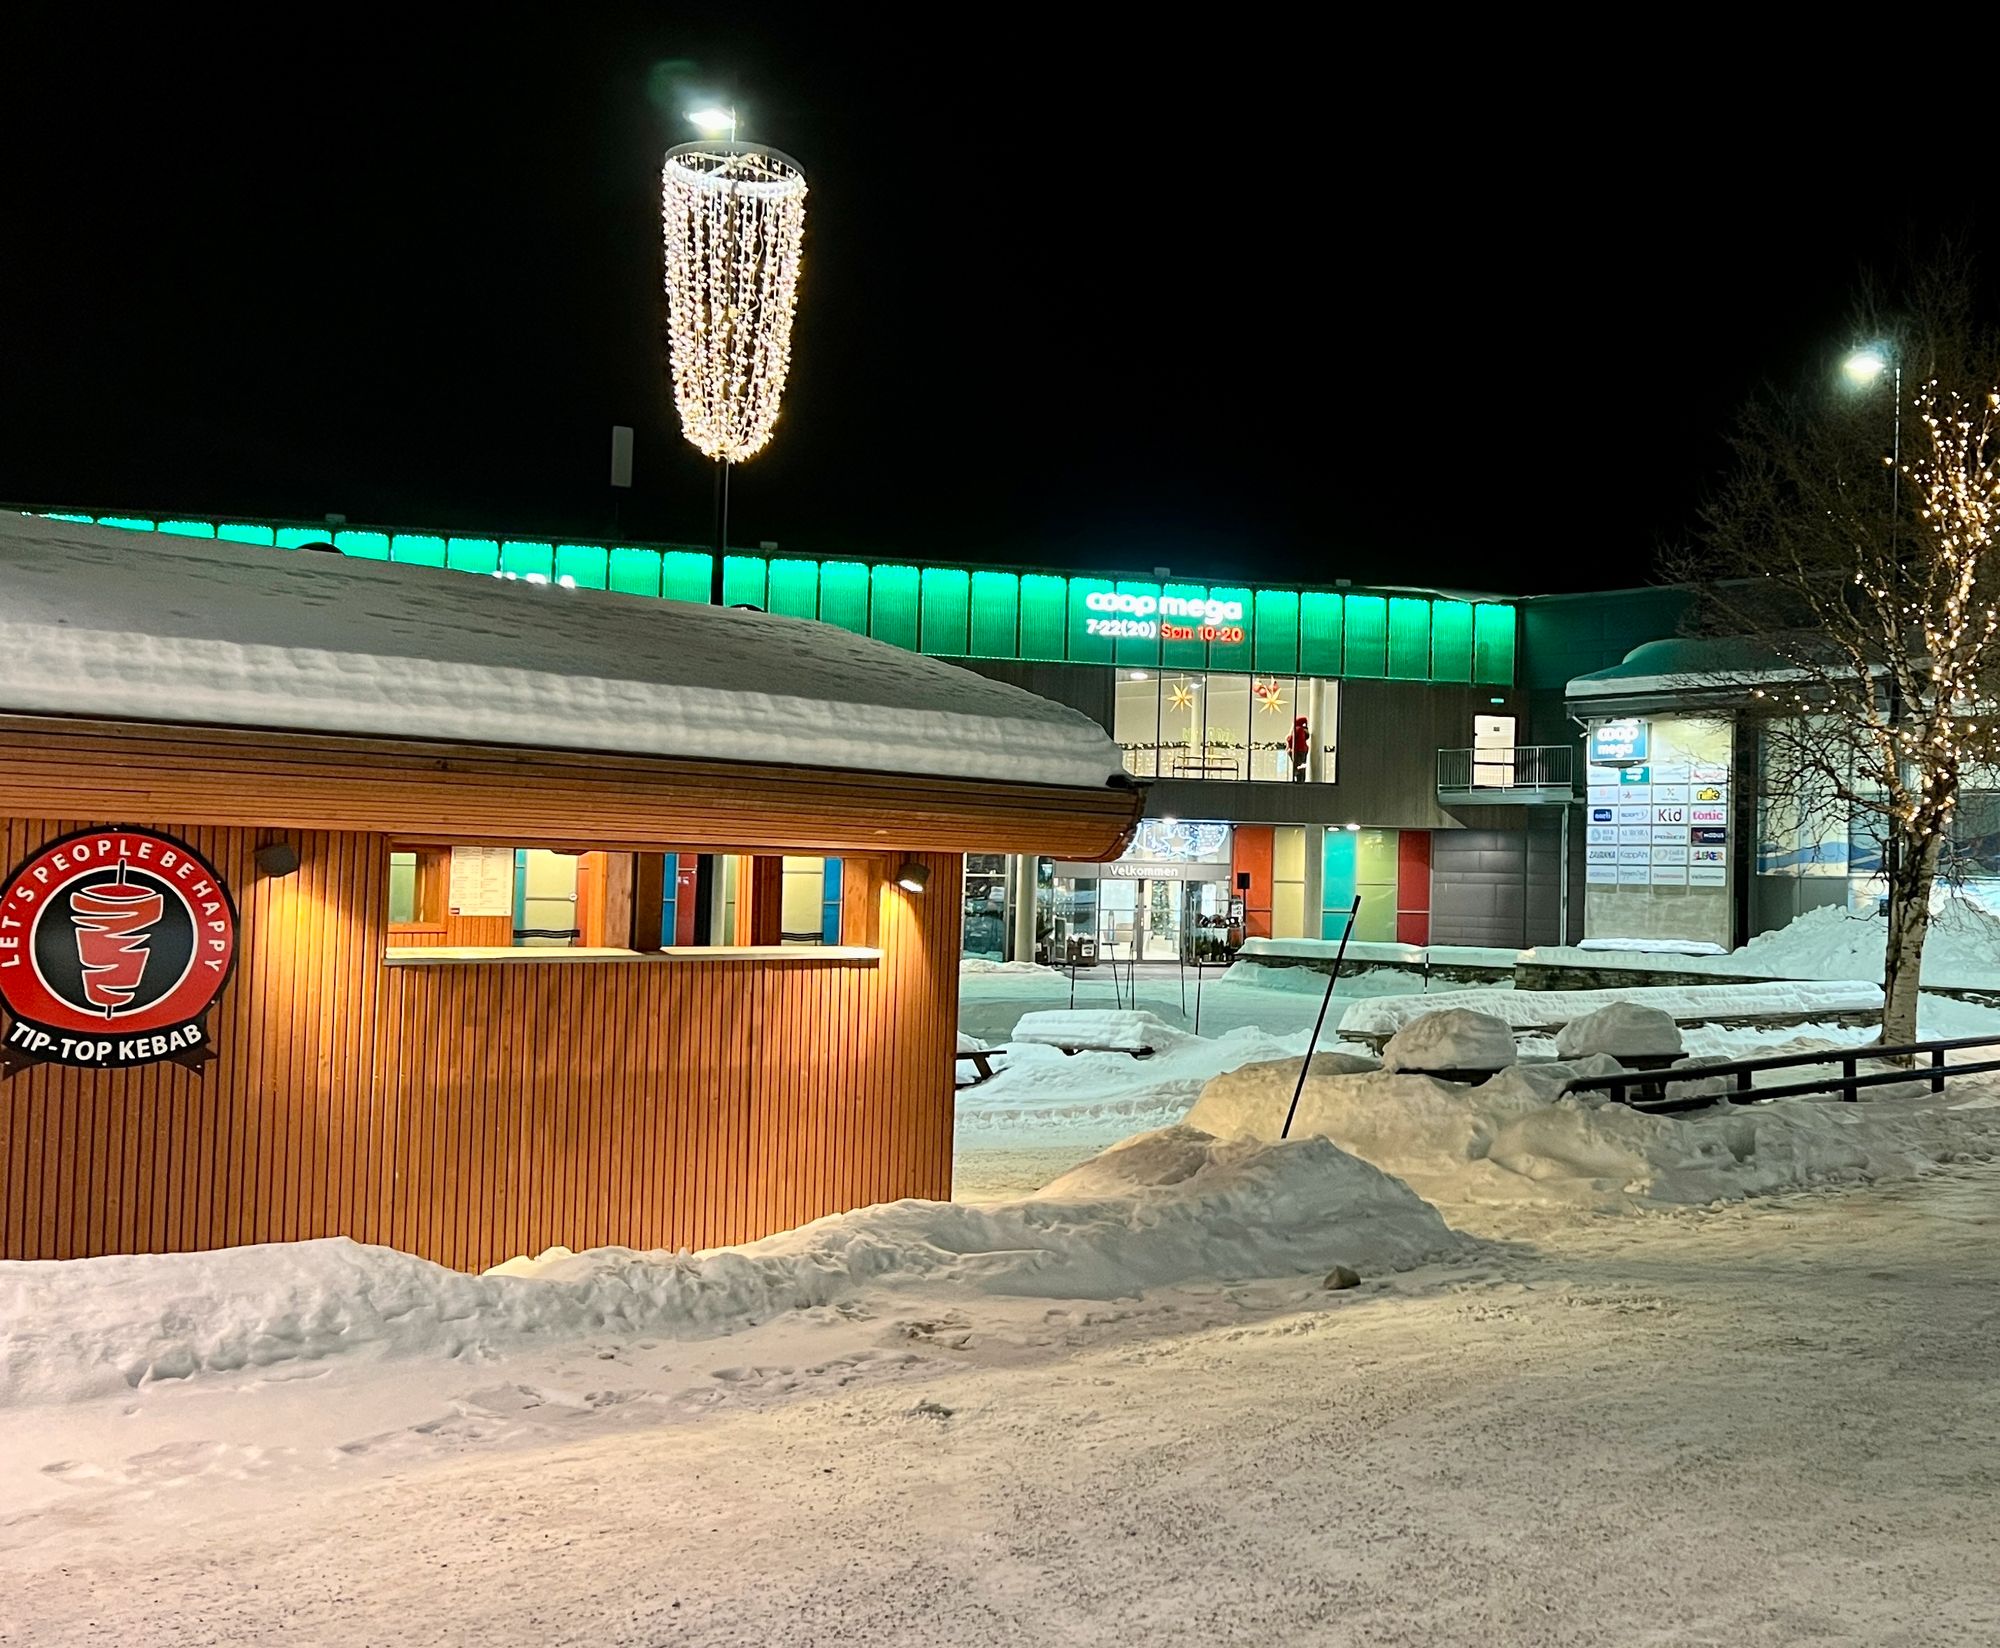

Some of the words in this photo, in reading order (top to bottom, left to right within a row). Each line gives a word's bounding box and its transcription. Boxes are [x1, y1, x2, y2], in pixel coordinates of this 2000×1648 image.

[1085, 592, 1157, 617] coop
[1159, 597, 1243, 625] mega
[1086, 619, 1157, 638] 7-22(20)
[1161, 624, 1194, 639] Søn
[1198, 626, 1244, 642] 10-20
[1597, 727, 1639, 742] coop
[1658, 808, 1682, 822] Kid
[1693, 809, 1723, 821] tonic
[1110, 864, 1179, 877] Velkommen
[0, 886, 35, 968] LET'S
[32, 839, 153, 884] PEOPLE
[159, 850, 195, 880] BE
[191, 879, 227, 972] HAPPY
[9, 1021, 112, 1062] TIP-TOP
[118, 1023, 202, 1061] KEBAB
